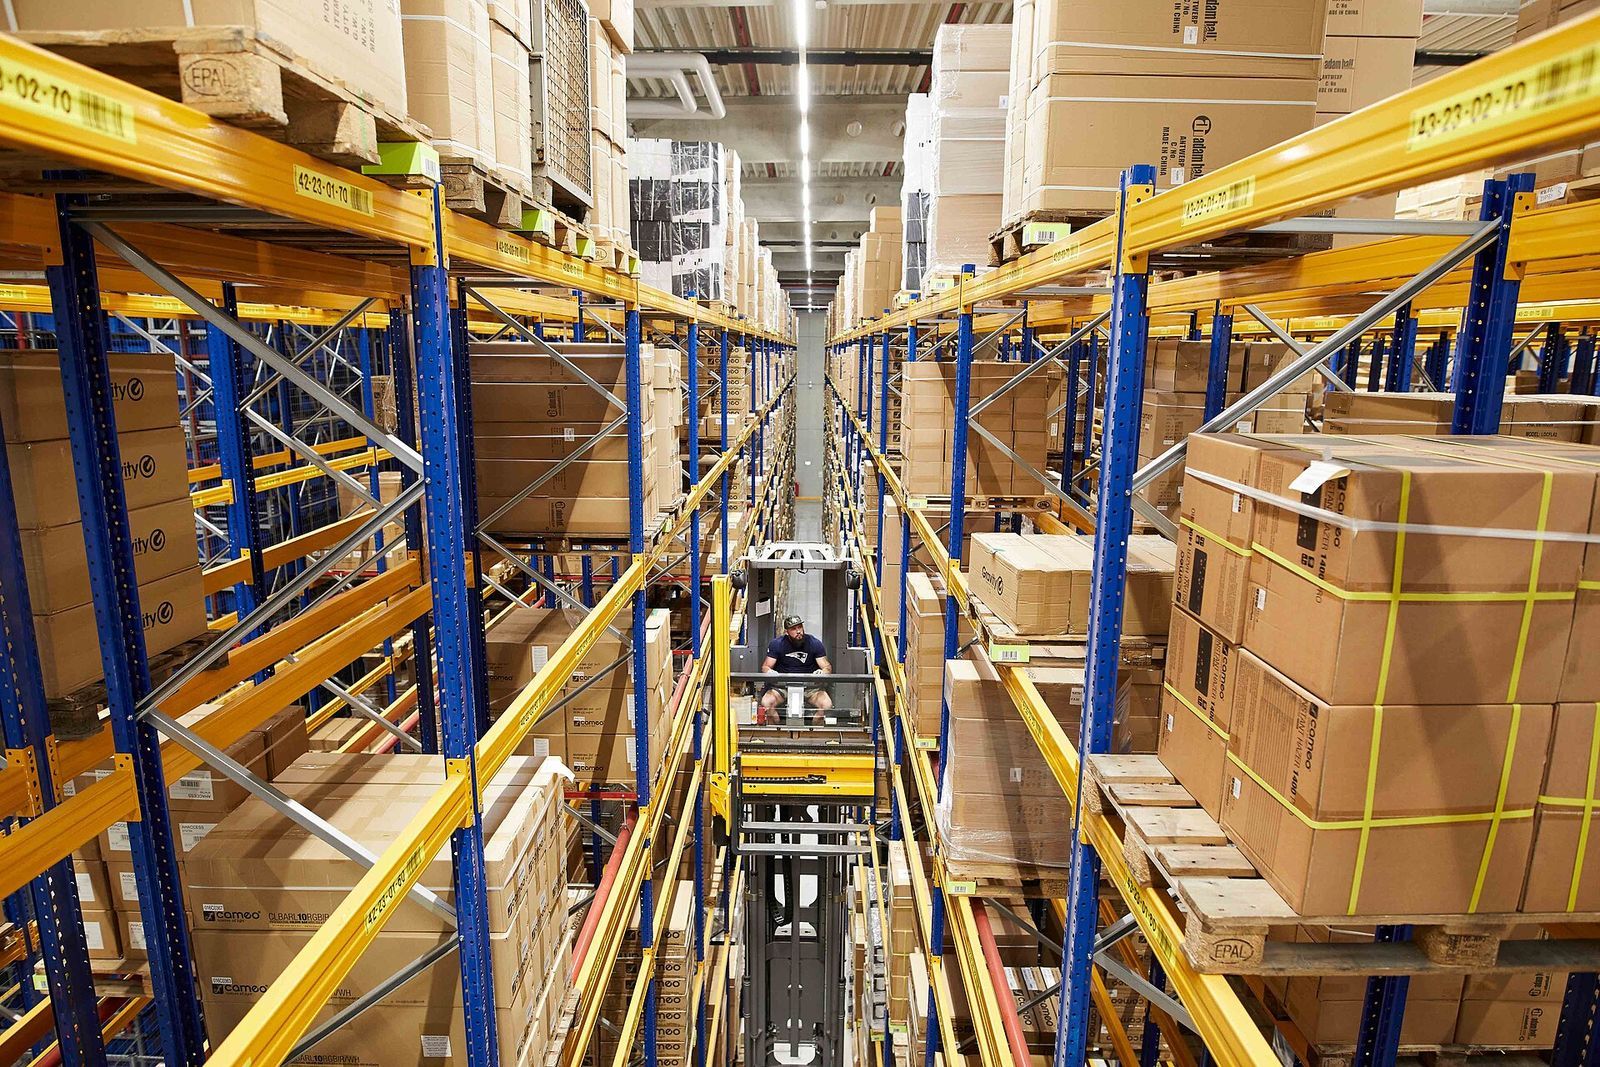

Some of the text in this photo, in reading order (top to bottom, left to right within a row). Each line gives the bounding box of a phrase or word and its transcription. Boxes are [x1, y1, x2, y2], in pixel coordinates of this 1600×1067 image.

[1172, 13, 1181, 33] CHINA
[191, 67, 234, 88] EPAL
[1324, 59, 1341, 70] adam
[1160, 126, 1170, 176] MADE IN CHINA
[1178, 135, 1187, 167] ANTWERP
[1191, 137, 1206, 163] adam
[298, 172, 348, 204] 42-23-01-70
[981, 566, 997, 590] Gravity
[1176, 550, 1185, 591] cameo
[1219, 656, 1228, 700] cameo
[1304, 719, 1317, 770] cameo
[1290, 769, 1300, 796] 1400
[368, 869, 406, 925] 42-23-01-60
[216, 911, 260, 920] cameo
[1214, 944, 1247, 959] EPAL
[225, 984, 268, 993] cameo
